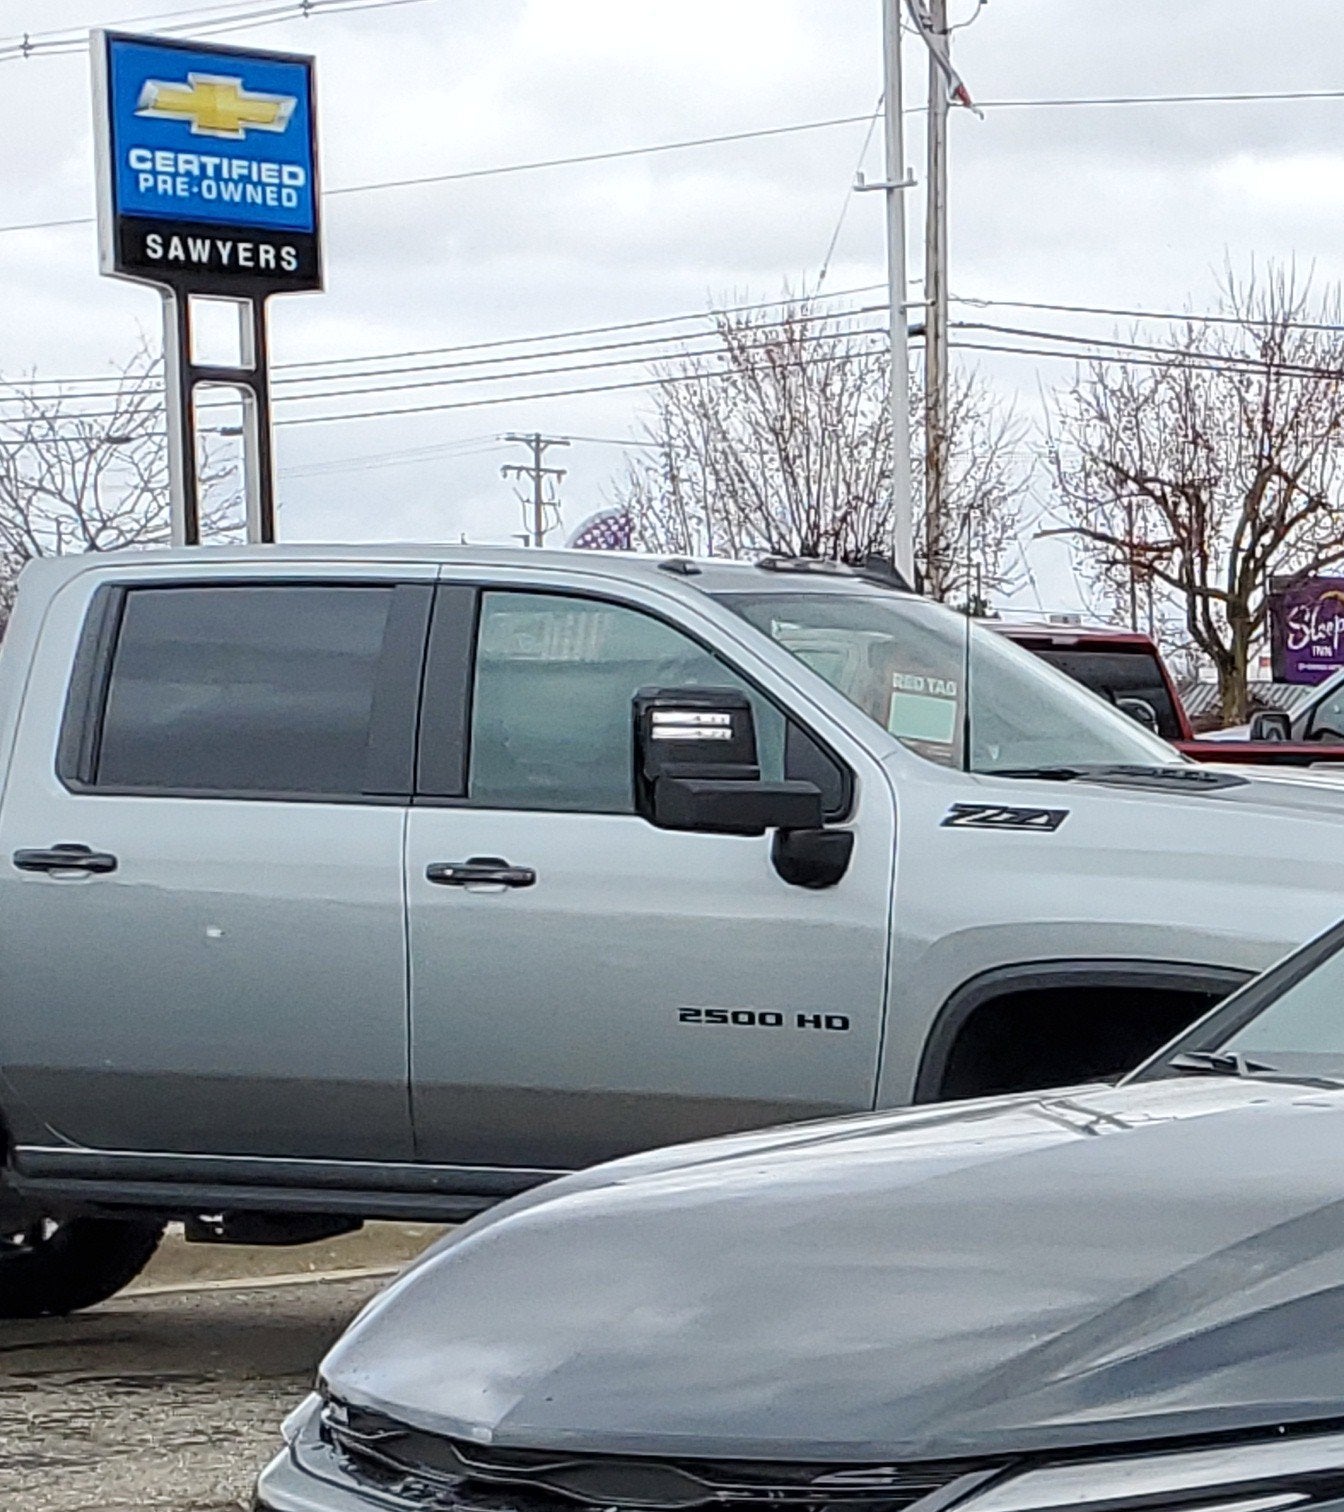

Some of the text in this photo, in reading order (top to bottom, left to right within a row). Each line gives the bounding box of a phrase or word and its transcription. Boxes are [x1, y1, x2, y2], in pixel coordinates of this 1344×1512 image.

[129, 148, 307, 188] CERTIFIED
[138, 173, 299, 208] PRE-OWNED
[146, 234, 298, 271] SAWYERS
[677, 1007, 850, 1031] 2500 HD
